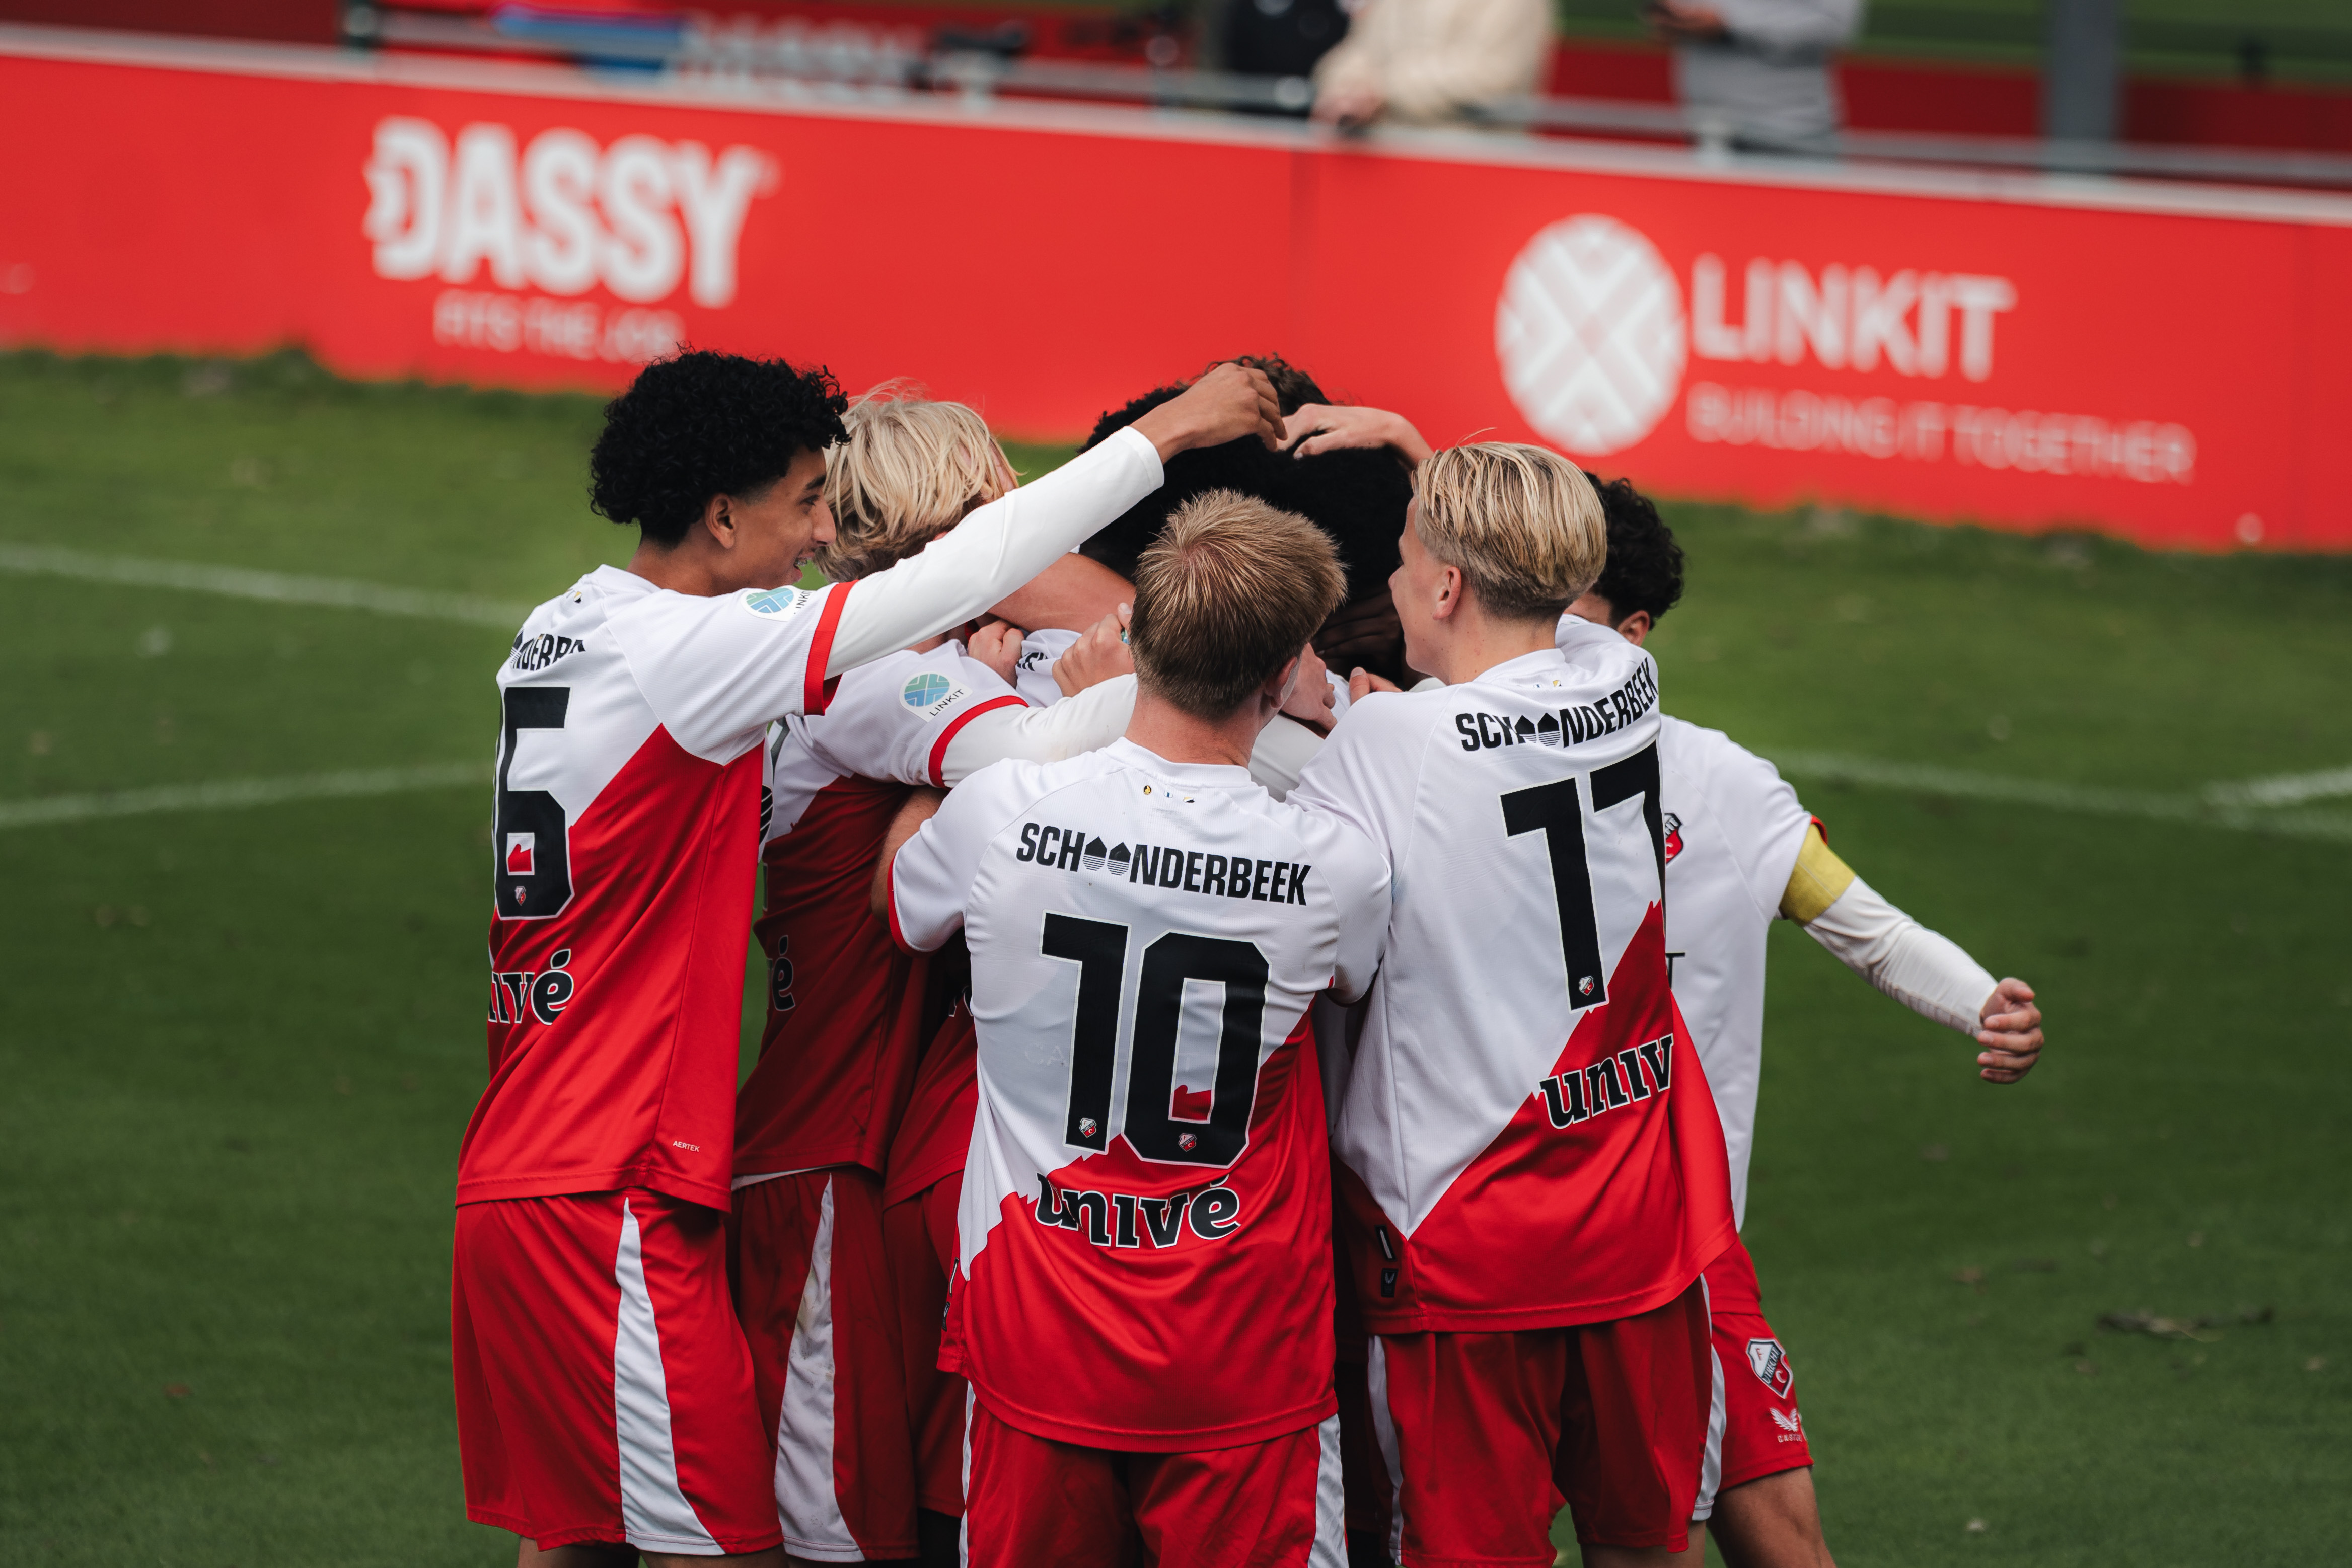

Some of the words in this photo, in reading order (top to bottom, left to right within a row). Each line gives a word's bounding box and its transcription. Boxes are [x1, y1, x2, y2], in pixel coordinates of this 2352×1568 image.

[363, 116, 770, 307] DASSY
[1692, 253, 2017, 382] LINKIT
[929, 689, 964, 716] LINKIT
[1497, 738, 1667, 1013] 17
[1039, 909, 1272, 1169] 10
[1538, 1033, 1673, 1129] univ
[1035, 1172, 1241, 1249] univé
